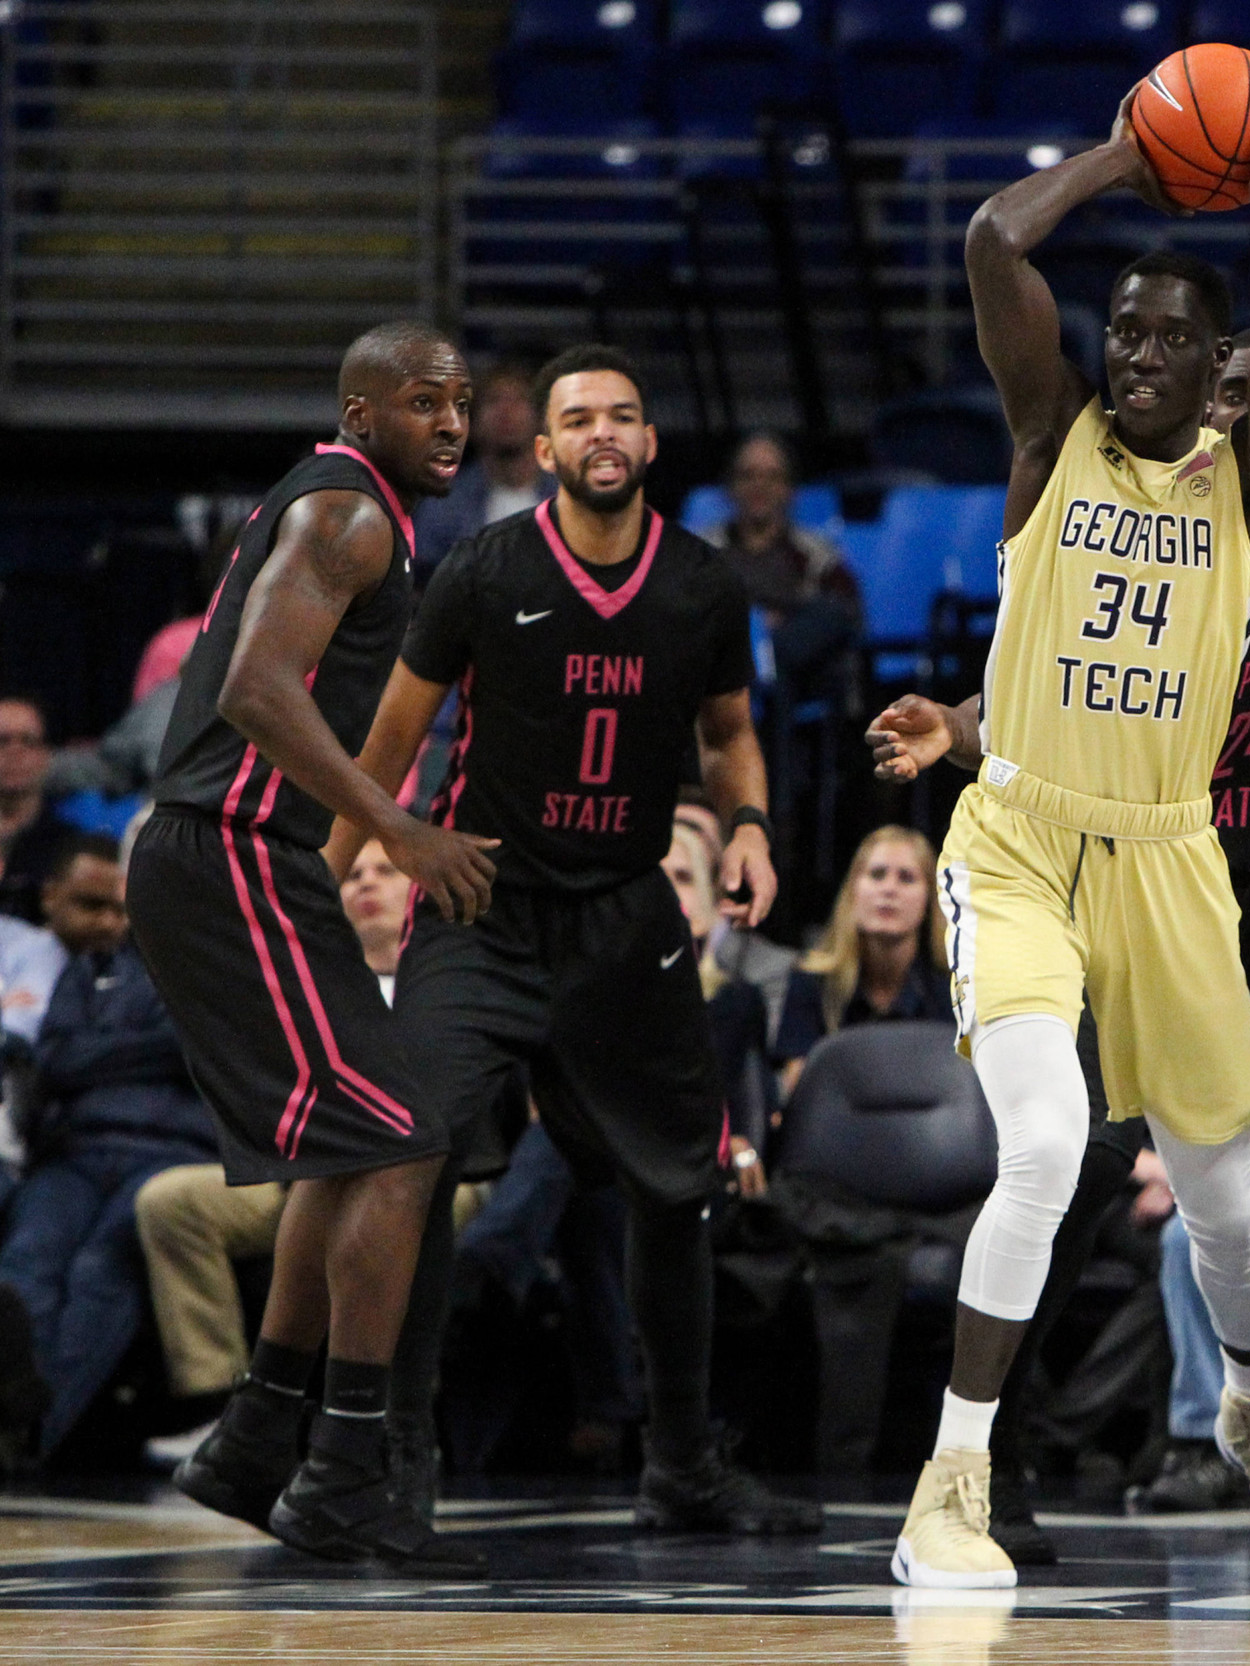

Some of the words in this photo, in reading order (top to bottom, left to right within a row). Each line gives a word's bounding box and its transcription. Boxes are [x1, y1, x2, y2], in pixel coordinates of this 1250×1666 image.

[1061, 499, 1212, 570] GEORGIA
[1080, 572, 1174, 648] 34
[564, 654, 644, 695] PENN
[1057, 656, 1188, 721] TECH
[579, 708, 618, 784] 0
[542, 792, 632, 834] STATE
